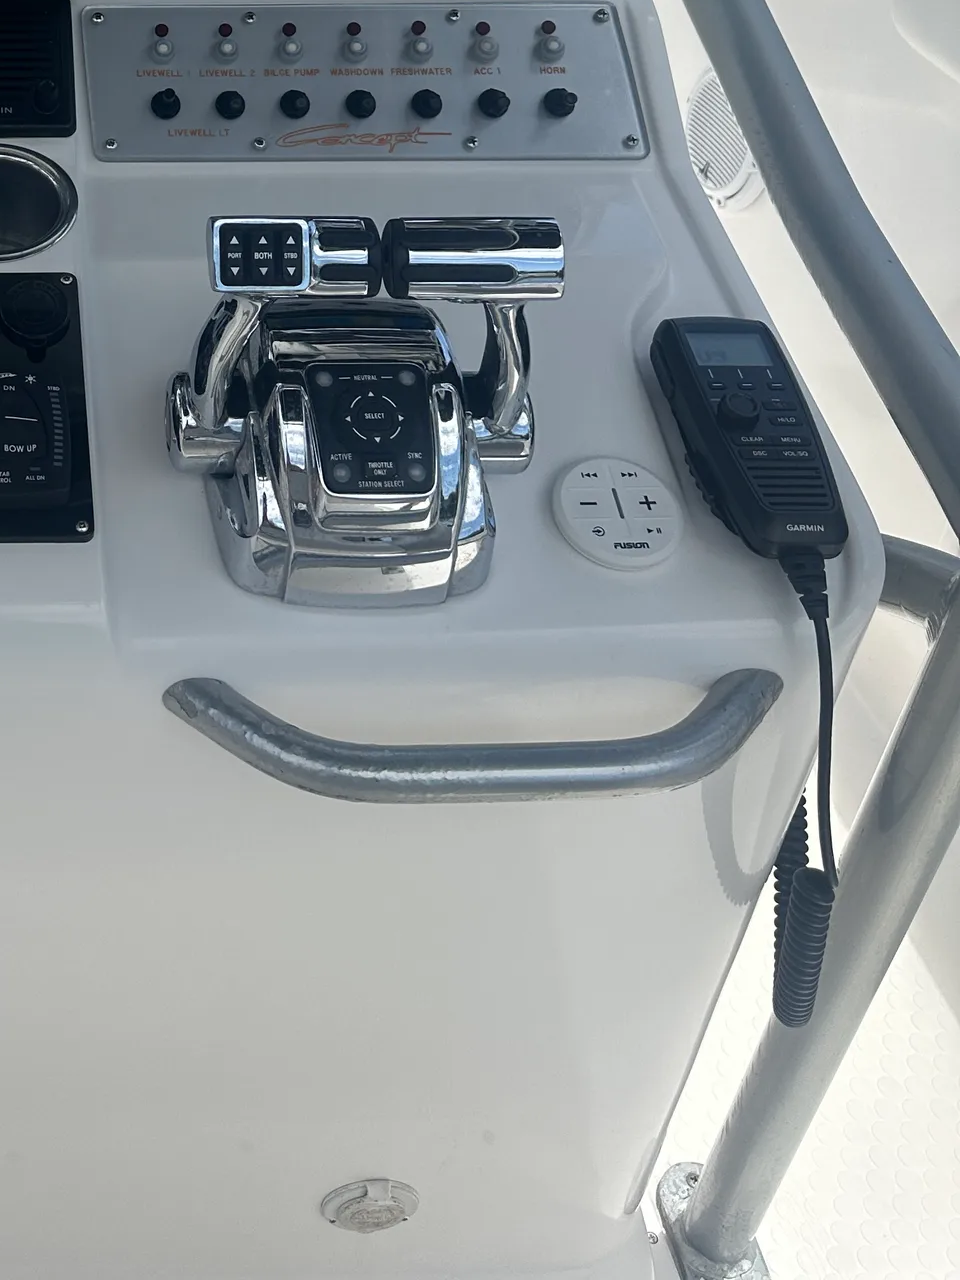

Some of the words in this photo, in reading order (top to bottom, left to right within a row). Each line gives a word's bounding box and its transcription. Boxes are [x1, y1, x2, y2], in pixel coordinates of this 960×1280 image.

[136, 69, 183, 77] LIVEWELL
[199, 69, 246, 77] LIVEWELL
[294, 68, 320, 76] PUMP
[330, 68, 384, 76] WASHDOWN
[391, 68, 452, 76] FRESHWATER
[474, 67, 493, 75] ACC
[540, 66, 566, 74] HORN
[168, 129, 215, 137] LIVEWELL
[219, 128, 230, 136] LT
[4, 444, 24, 453] BOW
[27, 444, 37, 452] UP
[384, 480, 405, 488] SELECT
[786, 523, 825, 532] GARMIN
